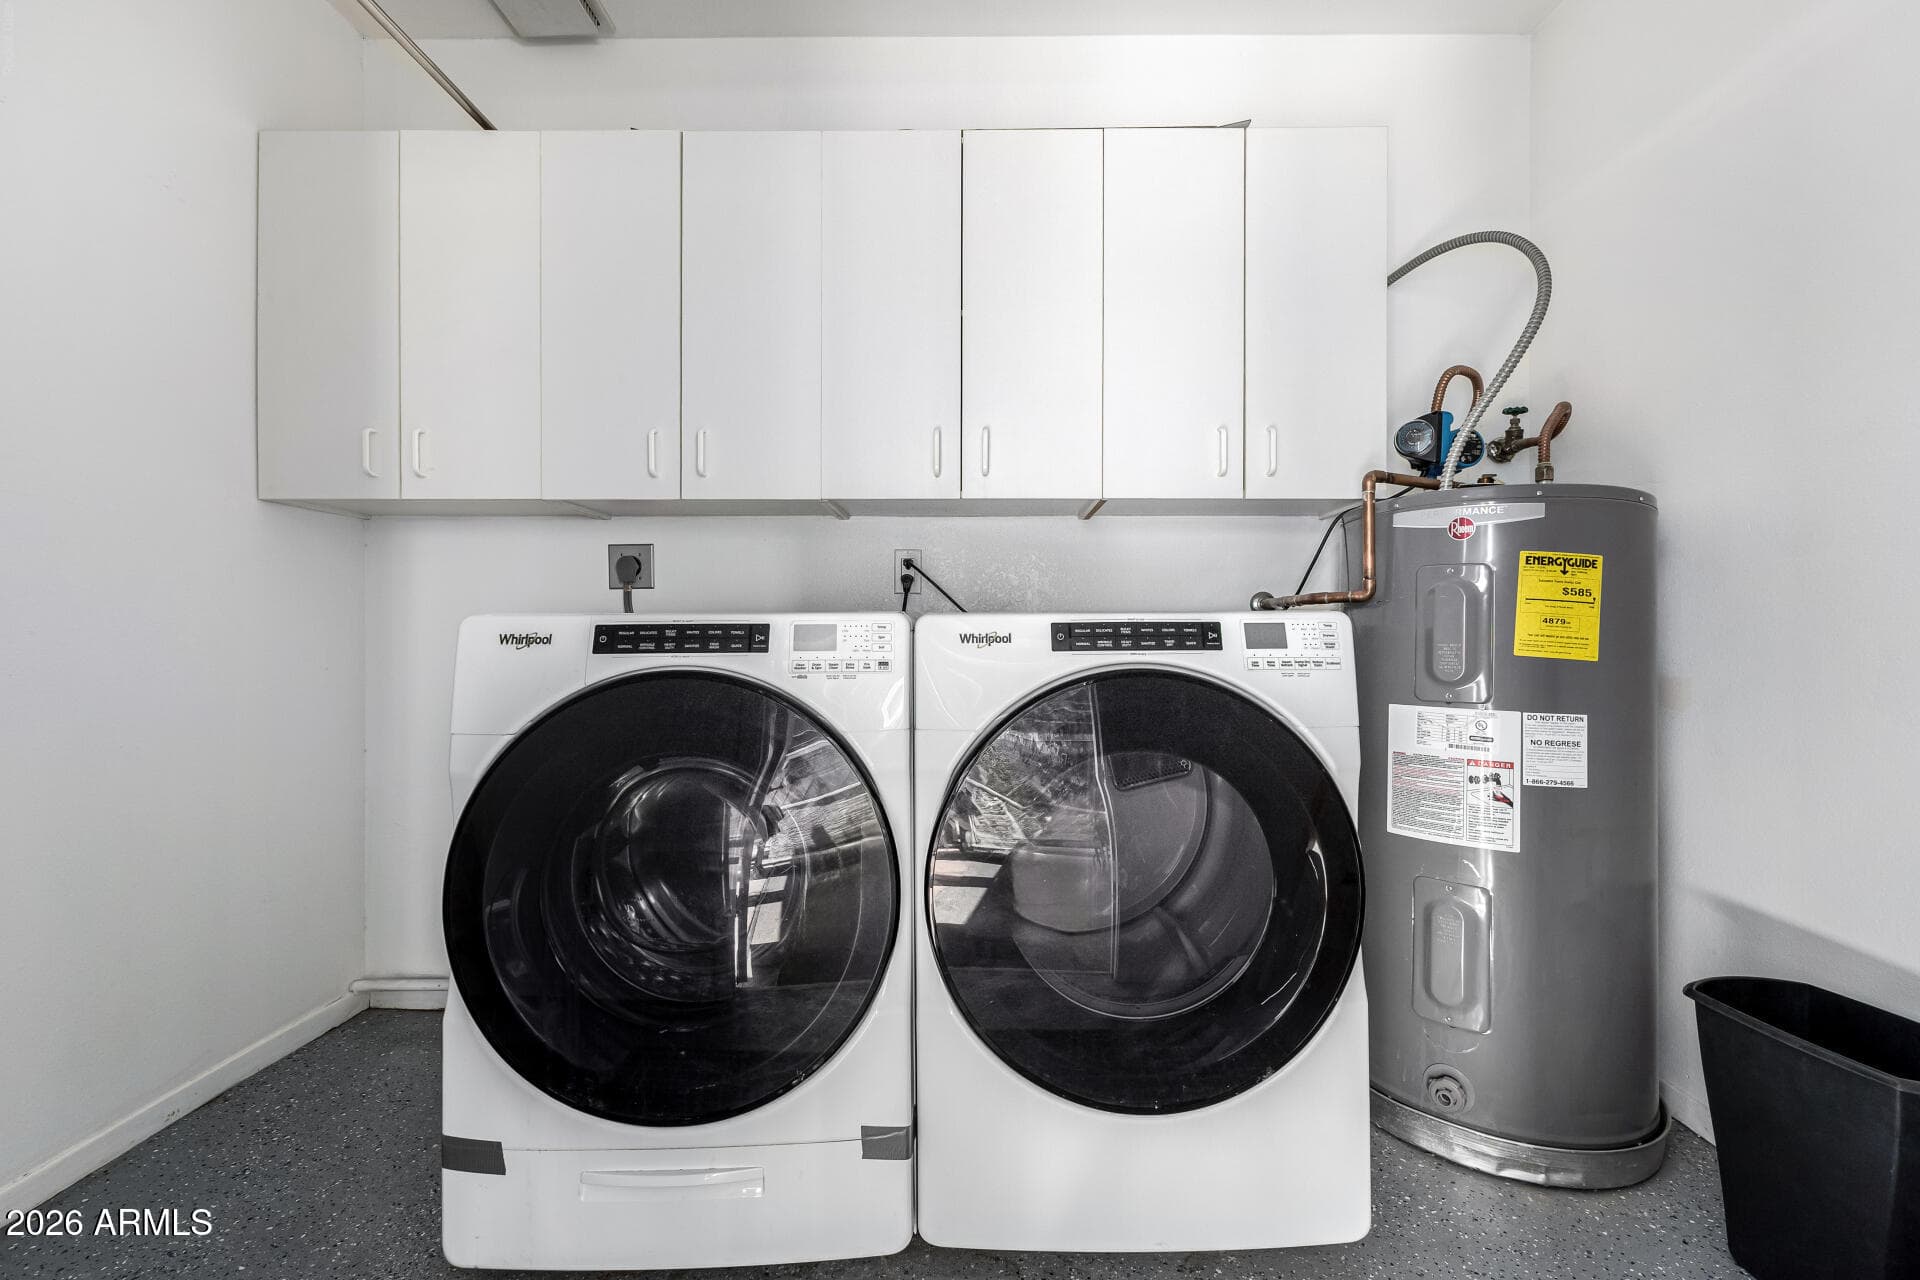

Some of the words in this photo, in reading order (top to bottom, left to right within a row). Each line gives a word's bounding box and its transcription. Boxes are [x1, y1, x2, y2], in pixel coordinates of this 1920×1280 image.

[1450, 521, 1474, 537] Rheem
[1525, 555, 1598, 569] ENERGYGUIDE
[1562, 587, 1592, 598] $585
[1542, 617, 1566, 625] 4879
[499, 632, 552, 649] Whirlpool
[959, 632, 1012, 648] Whirlpool
[1540, 714, 1555, 722] NOT
[1556, 715, 1584, 723] RETURN
[1544, 740, 1582, 748] REGRESE
[1477, 760, 1512, 769] DANGER
